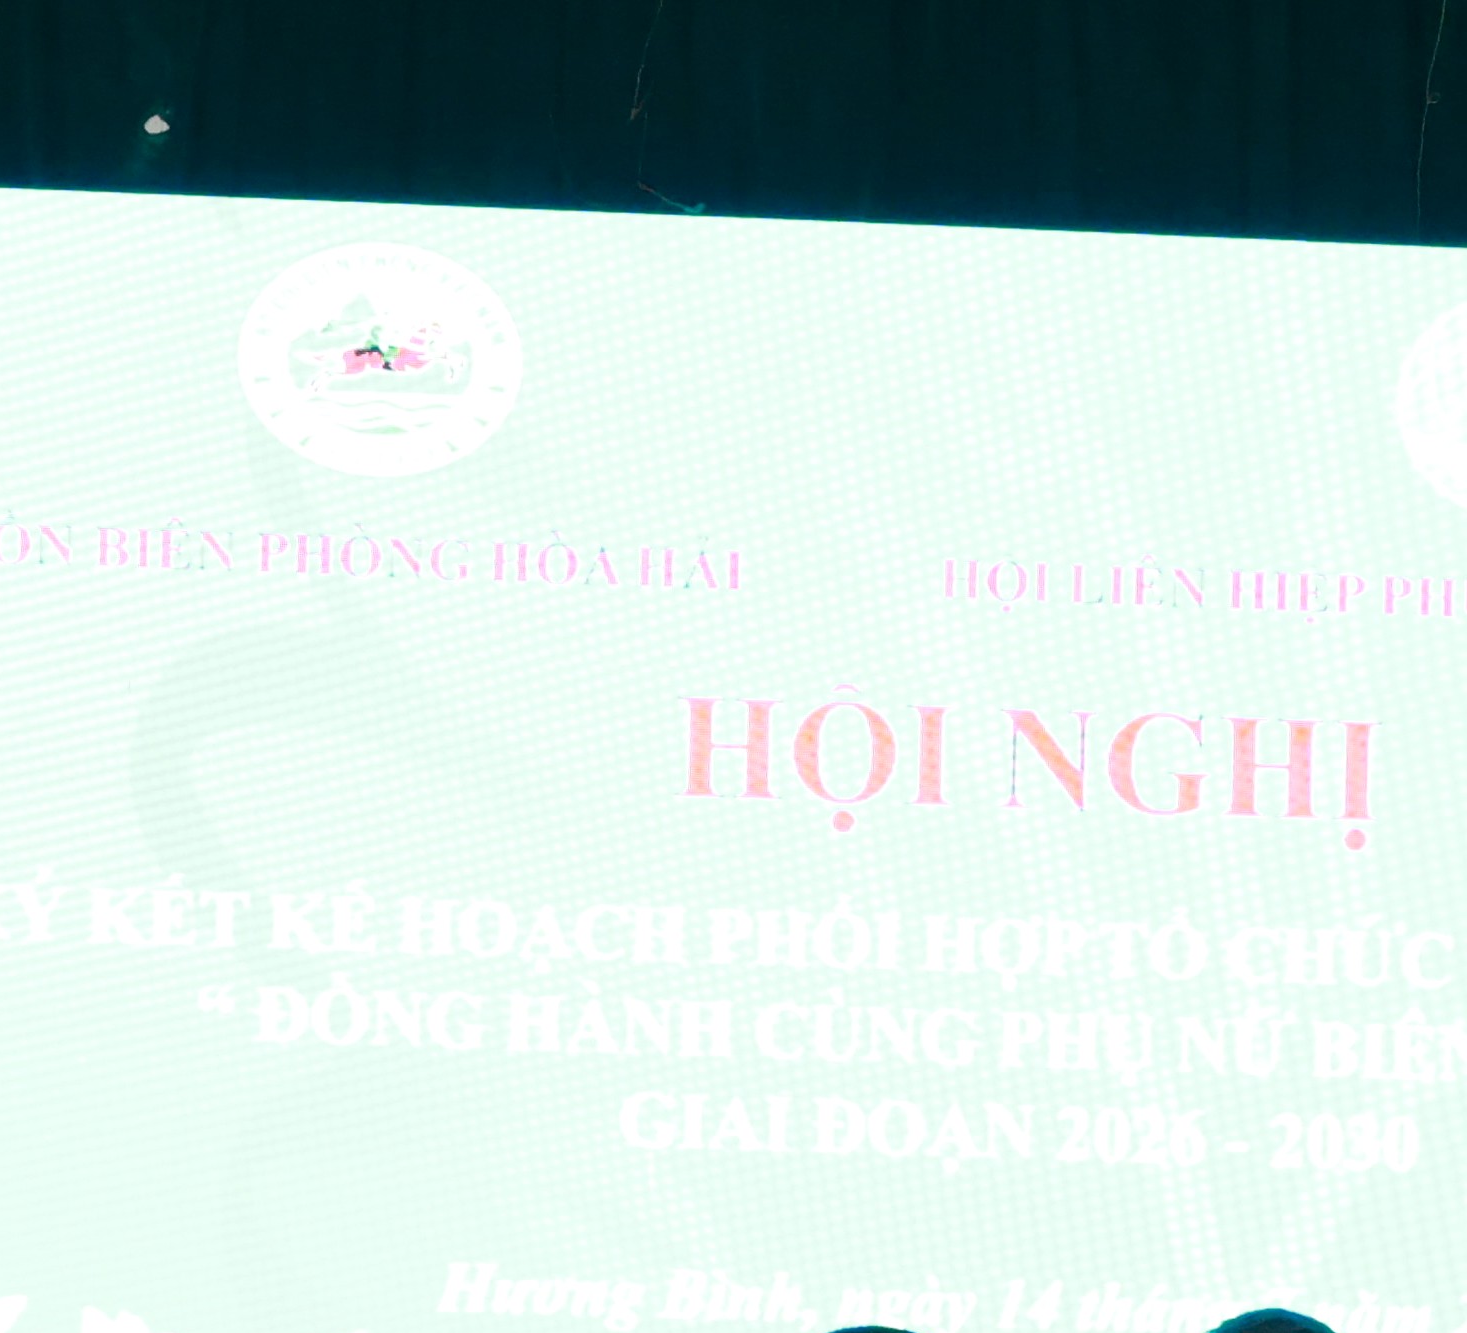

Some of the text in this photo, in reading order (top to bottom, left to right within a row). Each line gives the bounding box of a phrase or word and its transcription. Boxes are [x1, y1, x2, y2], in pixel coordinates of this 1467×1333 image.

[96, 517, 235, 572] BIÊN
[257, 522, 470, 582] PHÒNG
[1070, 554, 1207, 609] LIÊN
[676, 684, 1382, 852] HỘI NGHỊ
[86, 872, 251, 951] KẾT
[399, 895, 687, 976] HOẠCH
[505, 978, 736, 1058] HÀNH
[754, 988, 982, 1070] CÙNG
[997, 1007, 1156, 1087] PHỤ
[618, 1089, 793, 1157] GIAI
[811, 1096, 1037, 1176] ĐOẠN
[1054, 1103, 1208, 1168] 2026
[1267, 1109, 1422, 1174] 2030
